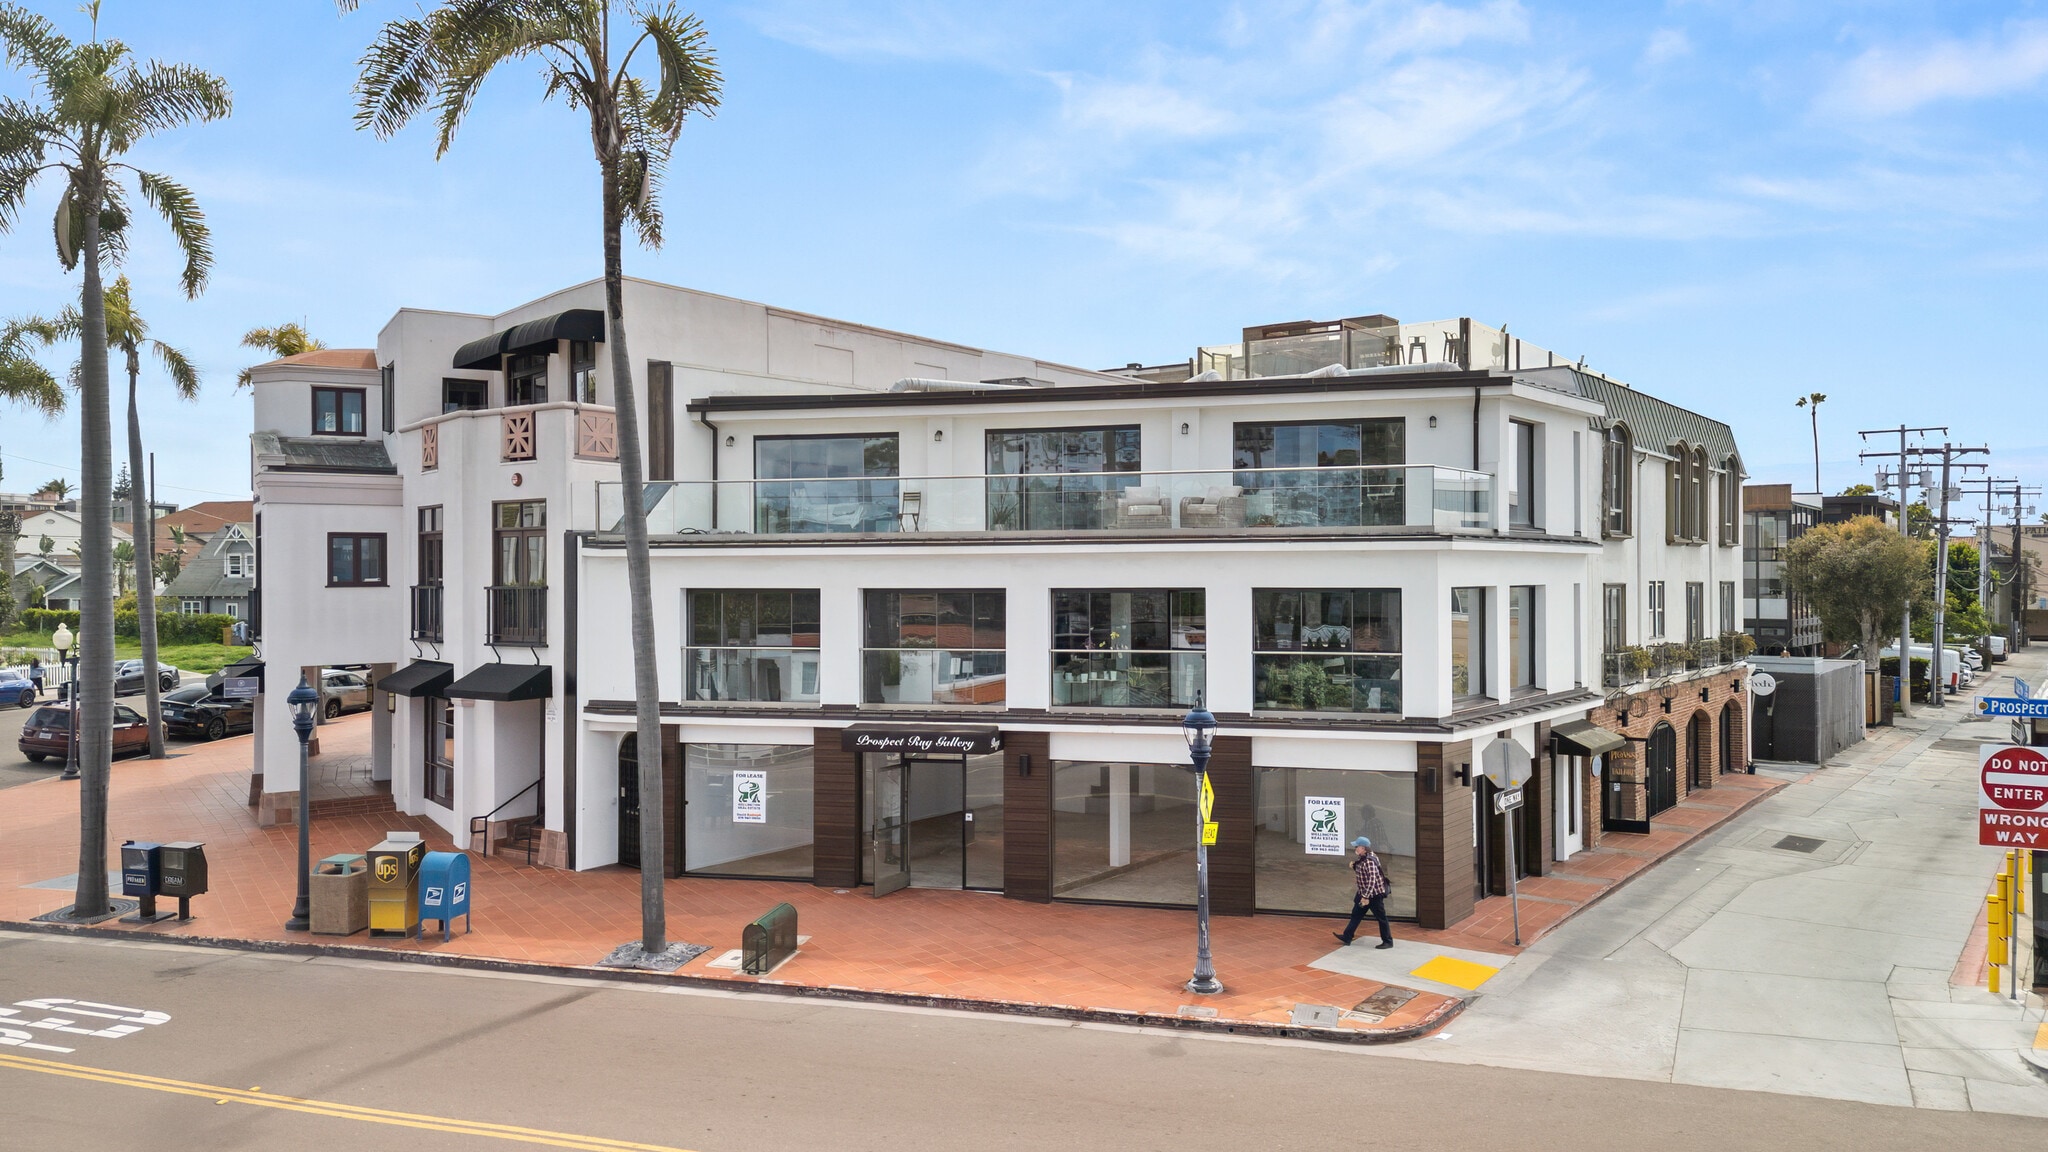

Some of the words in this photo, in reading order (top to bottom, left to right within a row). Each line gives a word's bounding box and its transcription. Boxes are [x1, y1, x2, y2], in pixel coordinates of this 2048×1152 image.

[1991, 700, 2048, 715] PROSPECT
[856, 734, 904, 749] Prospect
[908, 735, 932, 750] Rug
[935, 736, 975, 751] Gallery
[1992, 758, 2012, 770] DO
[2019, 760, 2048, 772] NOT
[1994, 787, 2043, 801] ENTER
[1984, 813, 2048, 828] WRONG
[1996, 830, 2039, 844] WAY
[377, 864, 397, 880] ups
